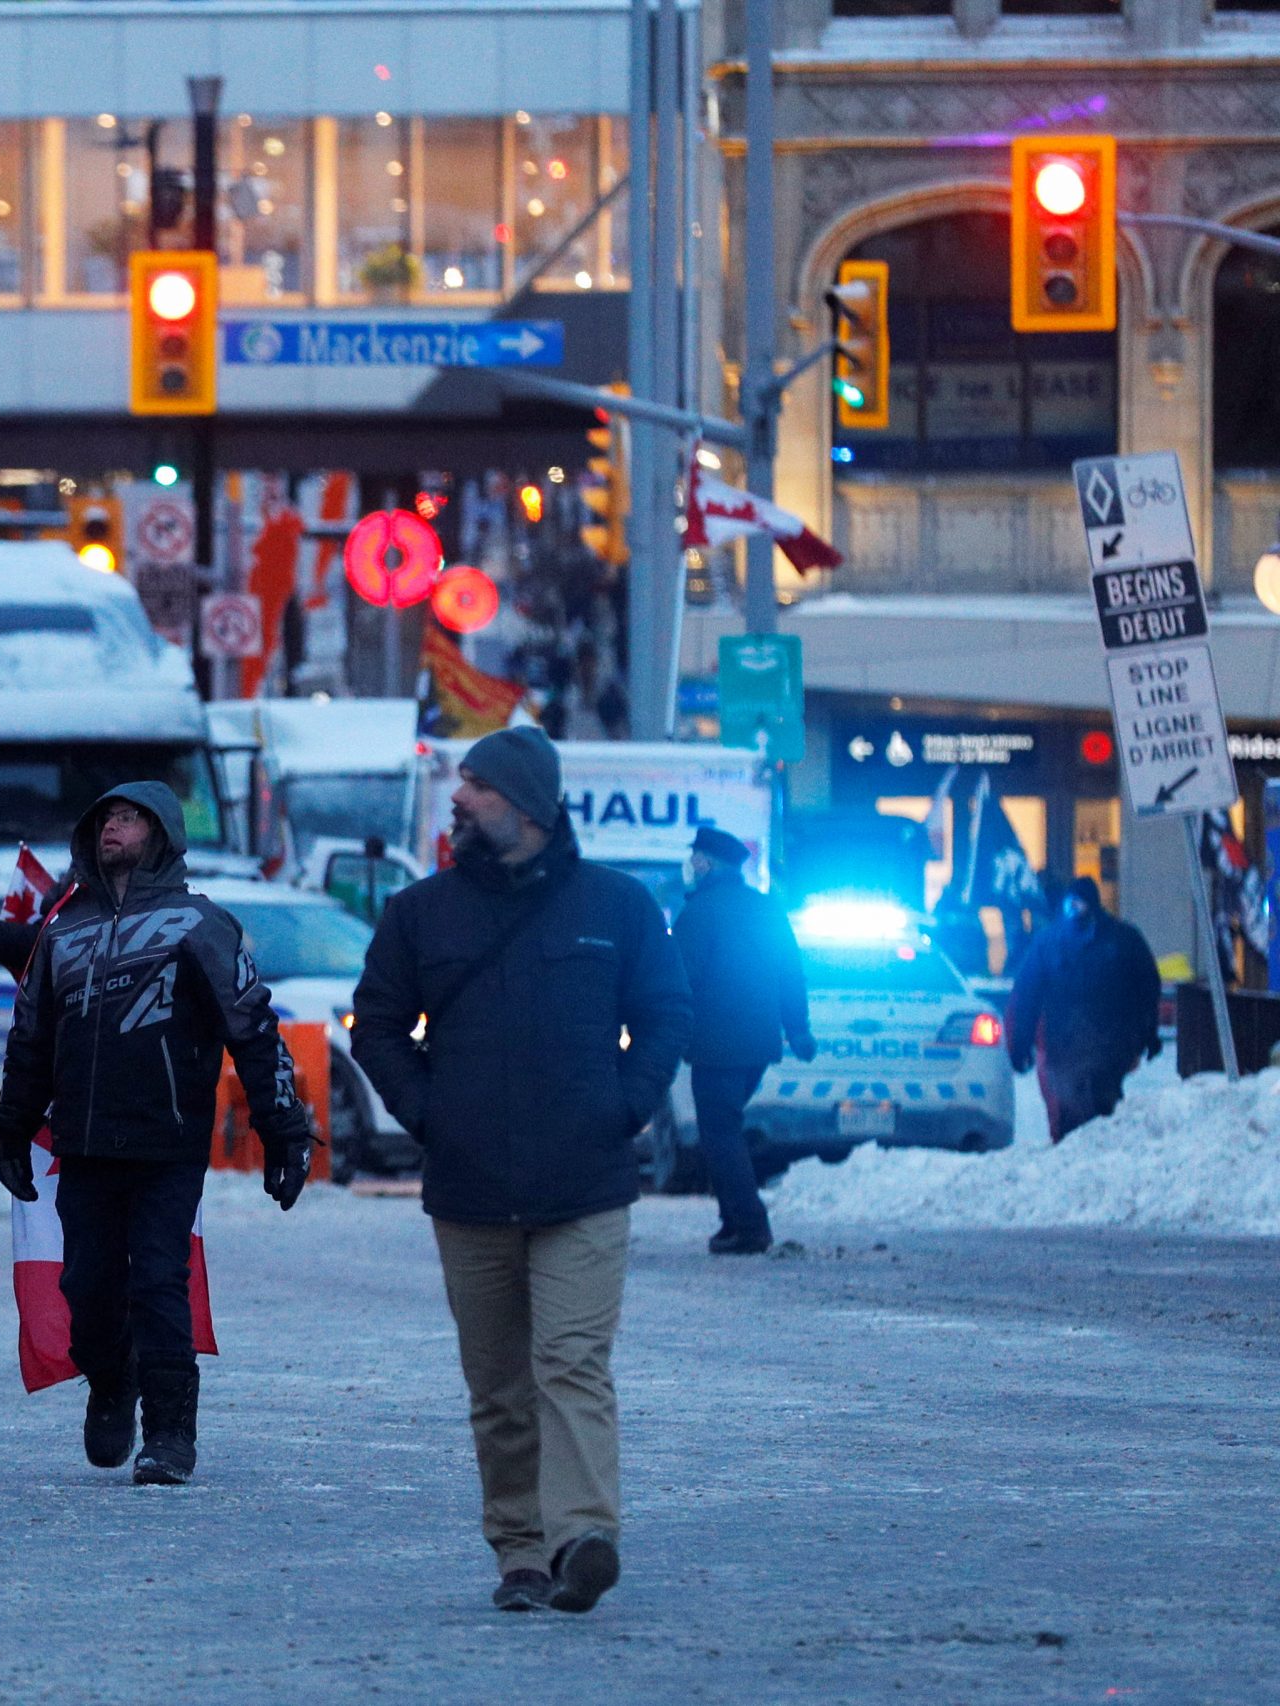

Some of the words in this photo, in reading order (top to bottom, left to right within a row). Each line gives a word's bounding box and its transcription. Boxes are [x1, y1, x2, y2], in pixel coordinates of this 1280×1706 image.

[298, 321, 480, 363] Mackenzie
[1105, 566, 1186, 608] BEGINS
[1129, 657, 1188, 685] STOP
[1136, 682, 1189, 708] LINE
[1133, 713, 1204, 740] LIGNE
[51, 906, 204, 986] FXR
[106, 974, 134, 991] CO.
